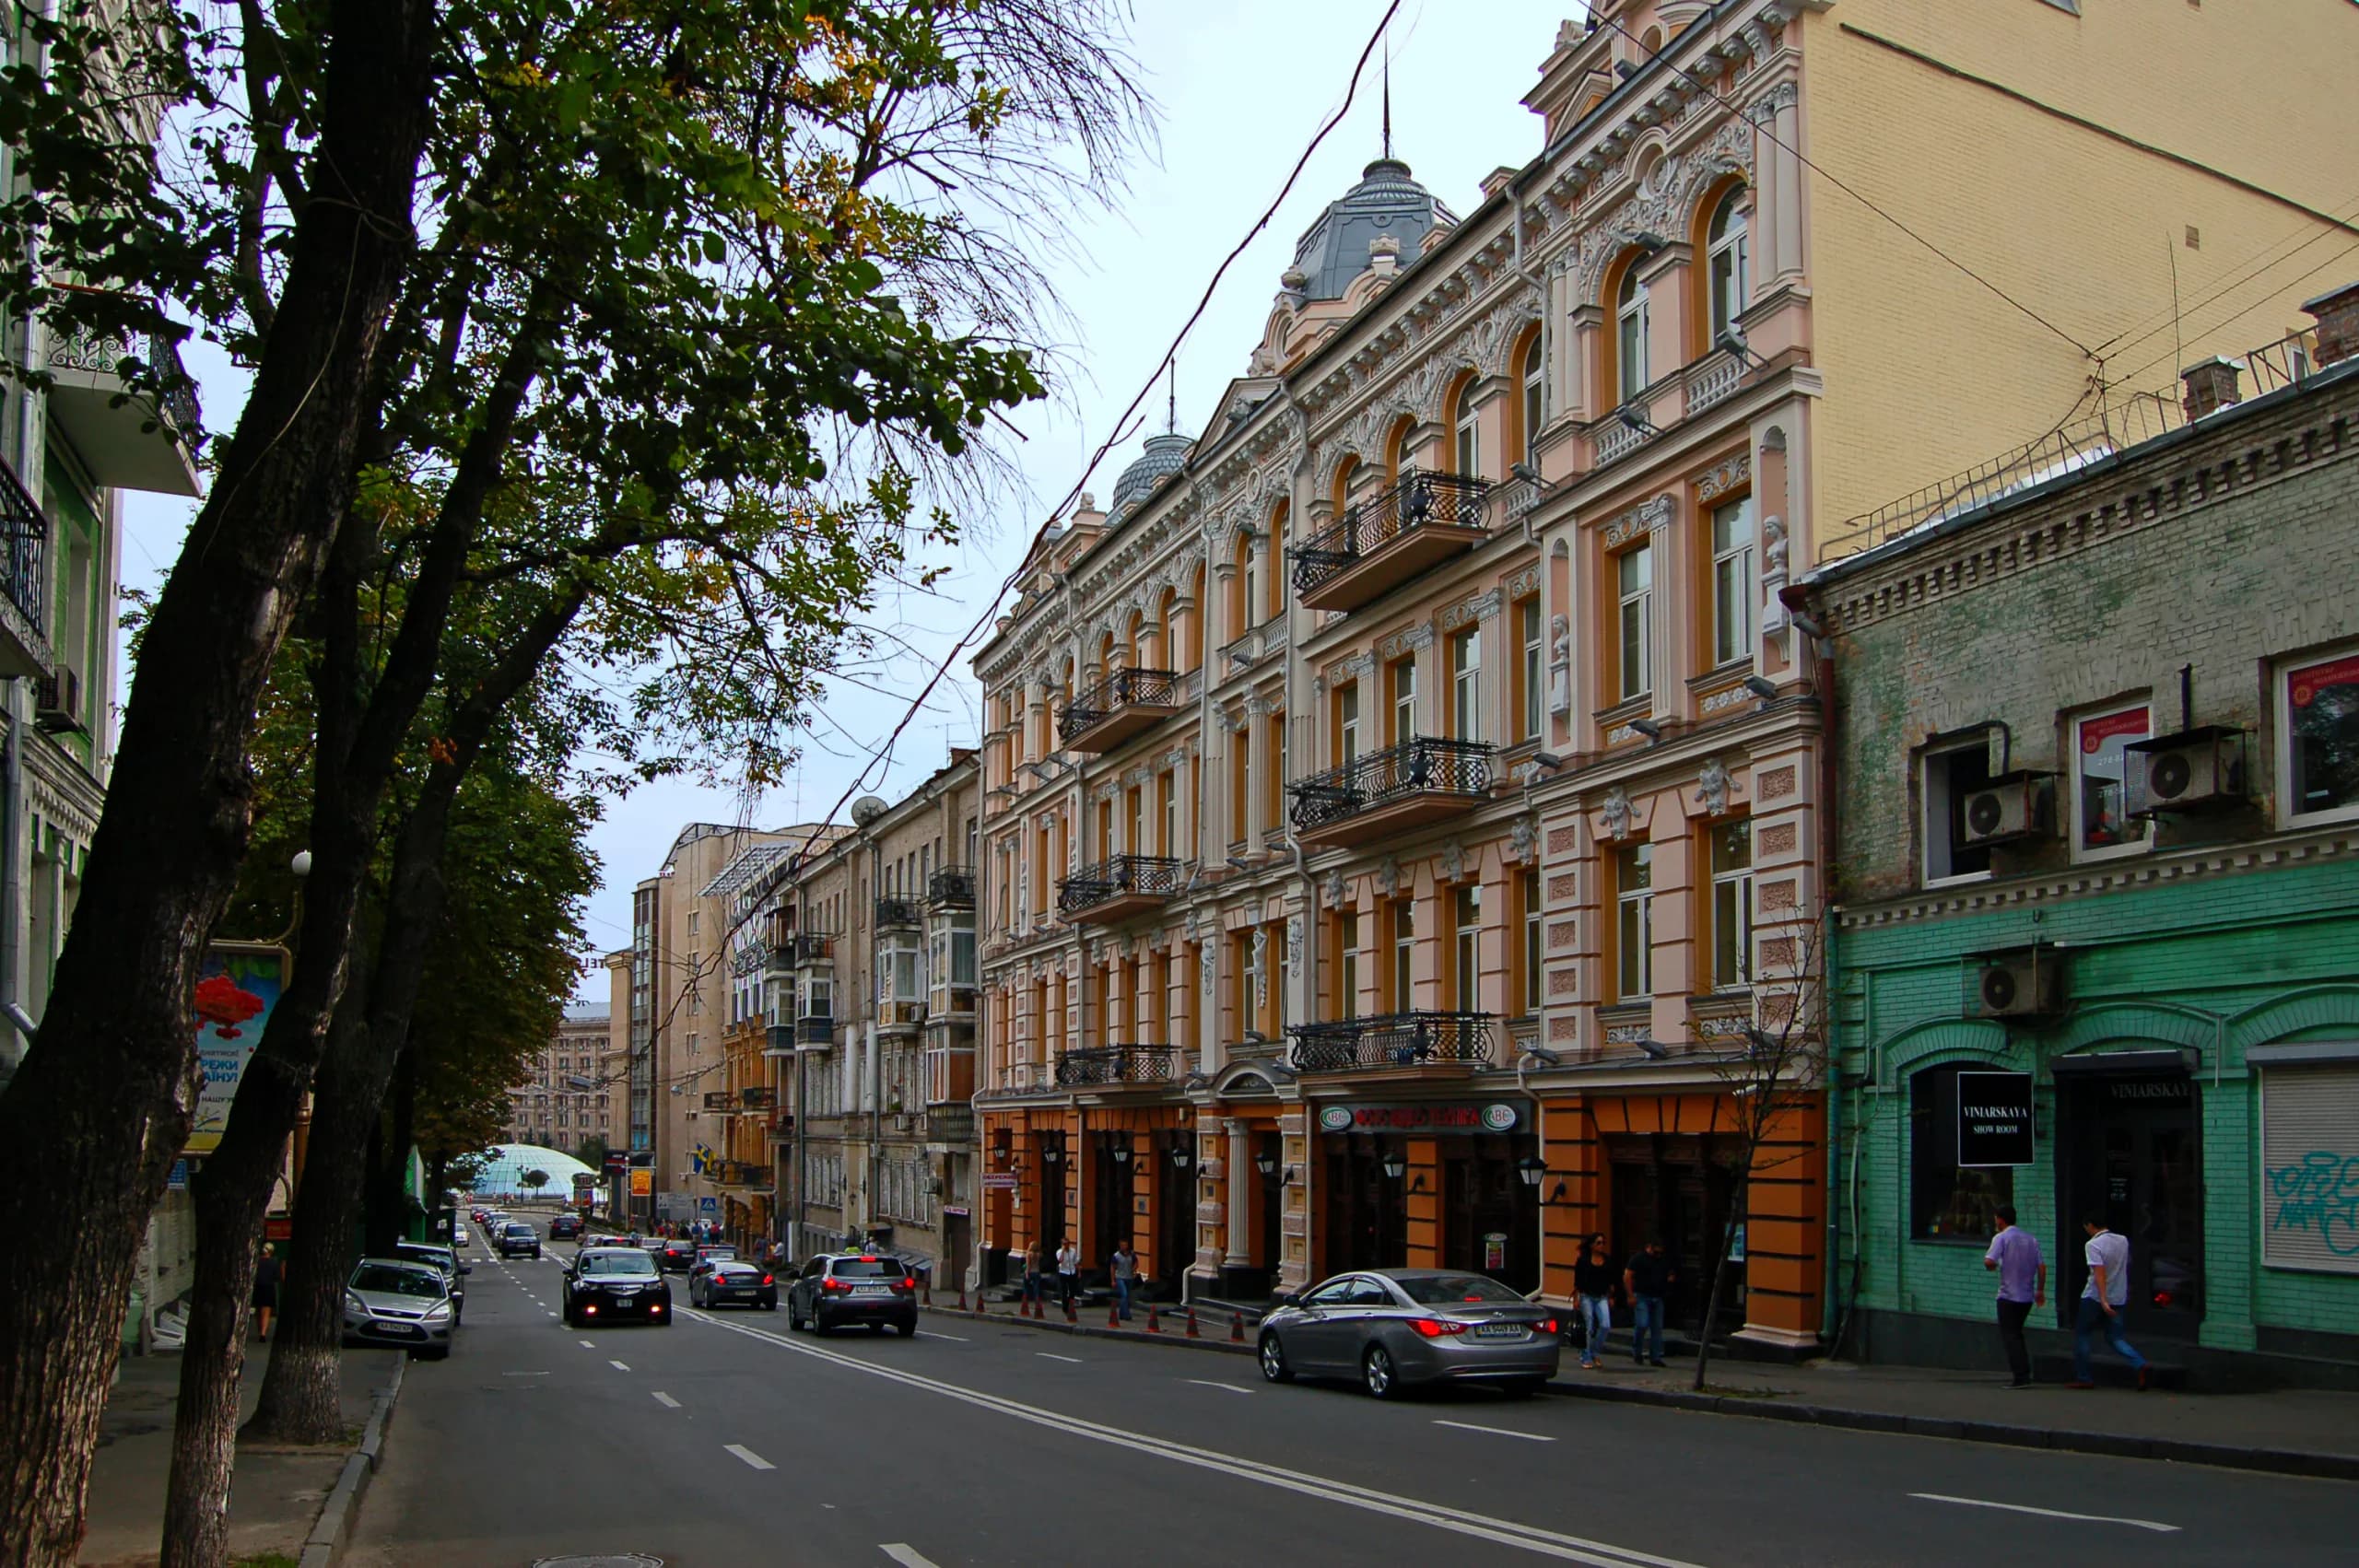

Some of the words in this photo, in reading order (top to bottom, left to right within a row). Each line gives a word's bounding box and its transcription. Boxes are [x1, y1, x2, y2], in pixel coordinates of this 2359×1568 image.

[200, 1060, 238, 1071] РЕЖИ
[203, 1071, 238, 1082] АЇНУ!
[2109, 1082, 2190, 1098] VINIARSKAY
[1964, 1106, 2028, 1118] VINIARSKAYA
[1972, 1124, 1994, 1134] SHOW
[1996, 1124, 2018, 1134] ROOM
